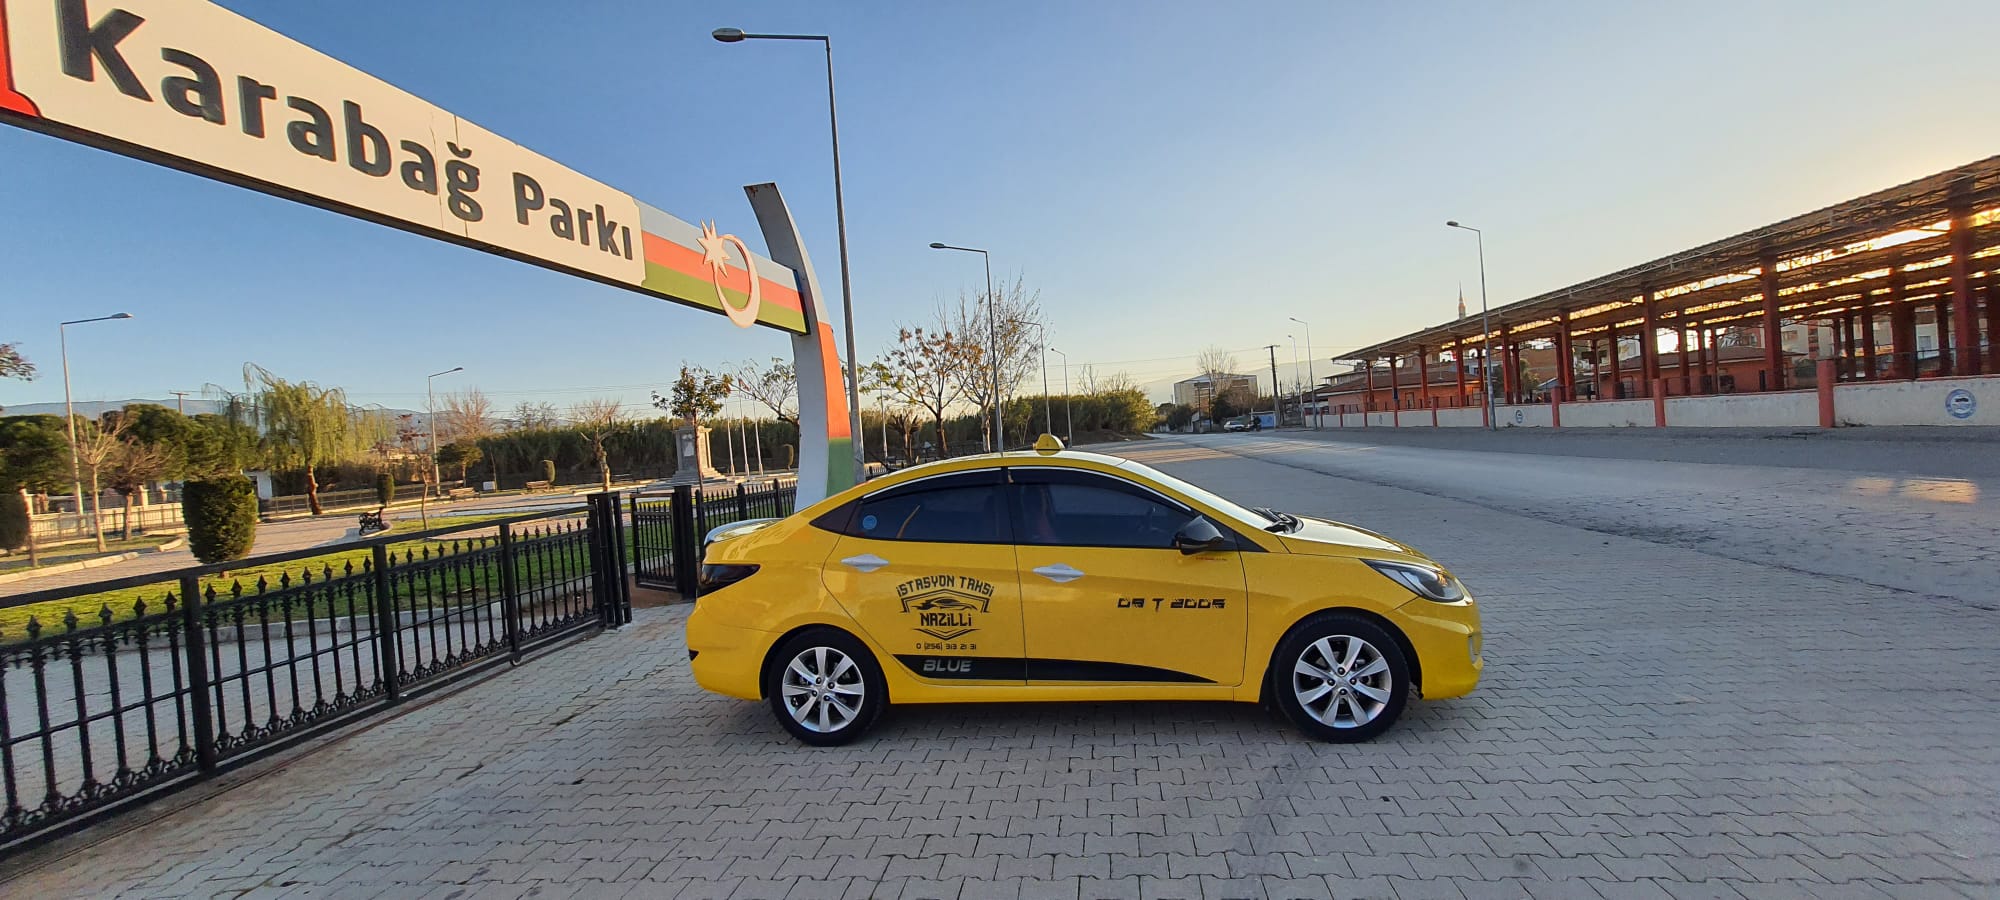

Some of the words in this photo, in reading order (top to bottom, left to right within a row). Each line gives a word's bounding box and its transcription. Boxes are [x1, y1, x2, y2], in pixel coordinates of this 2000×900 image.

[56, 0, 484, 222] Karabağ
[512, 172, 632, 260] Parkı
[1152, 598, 1164, 612] T
[923, 659, 972, 672] BLUE
